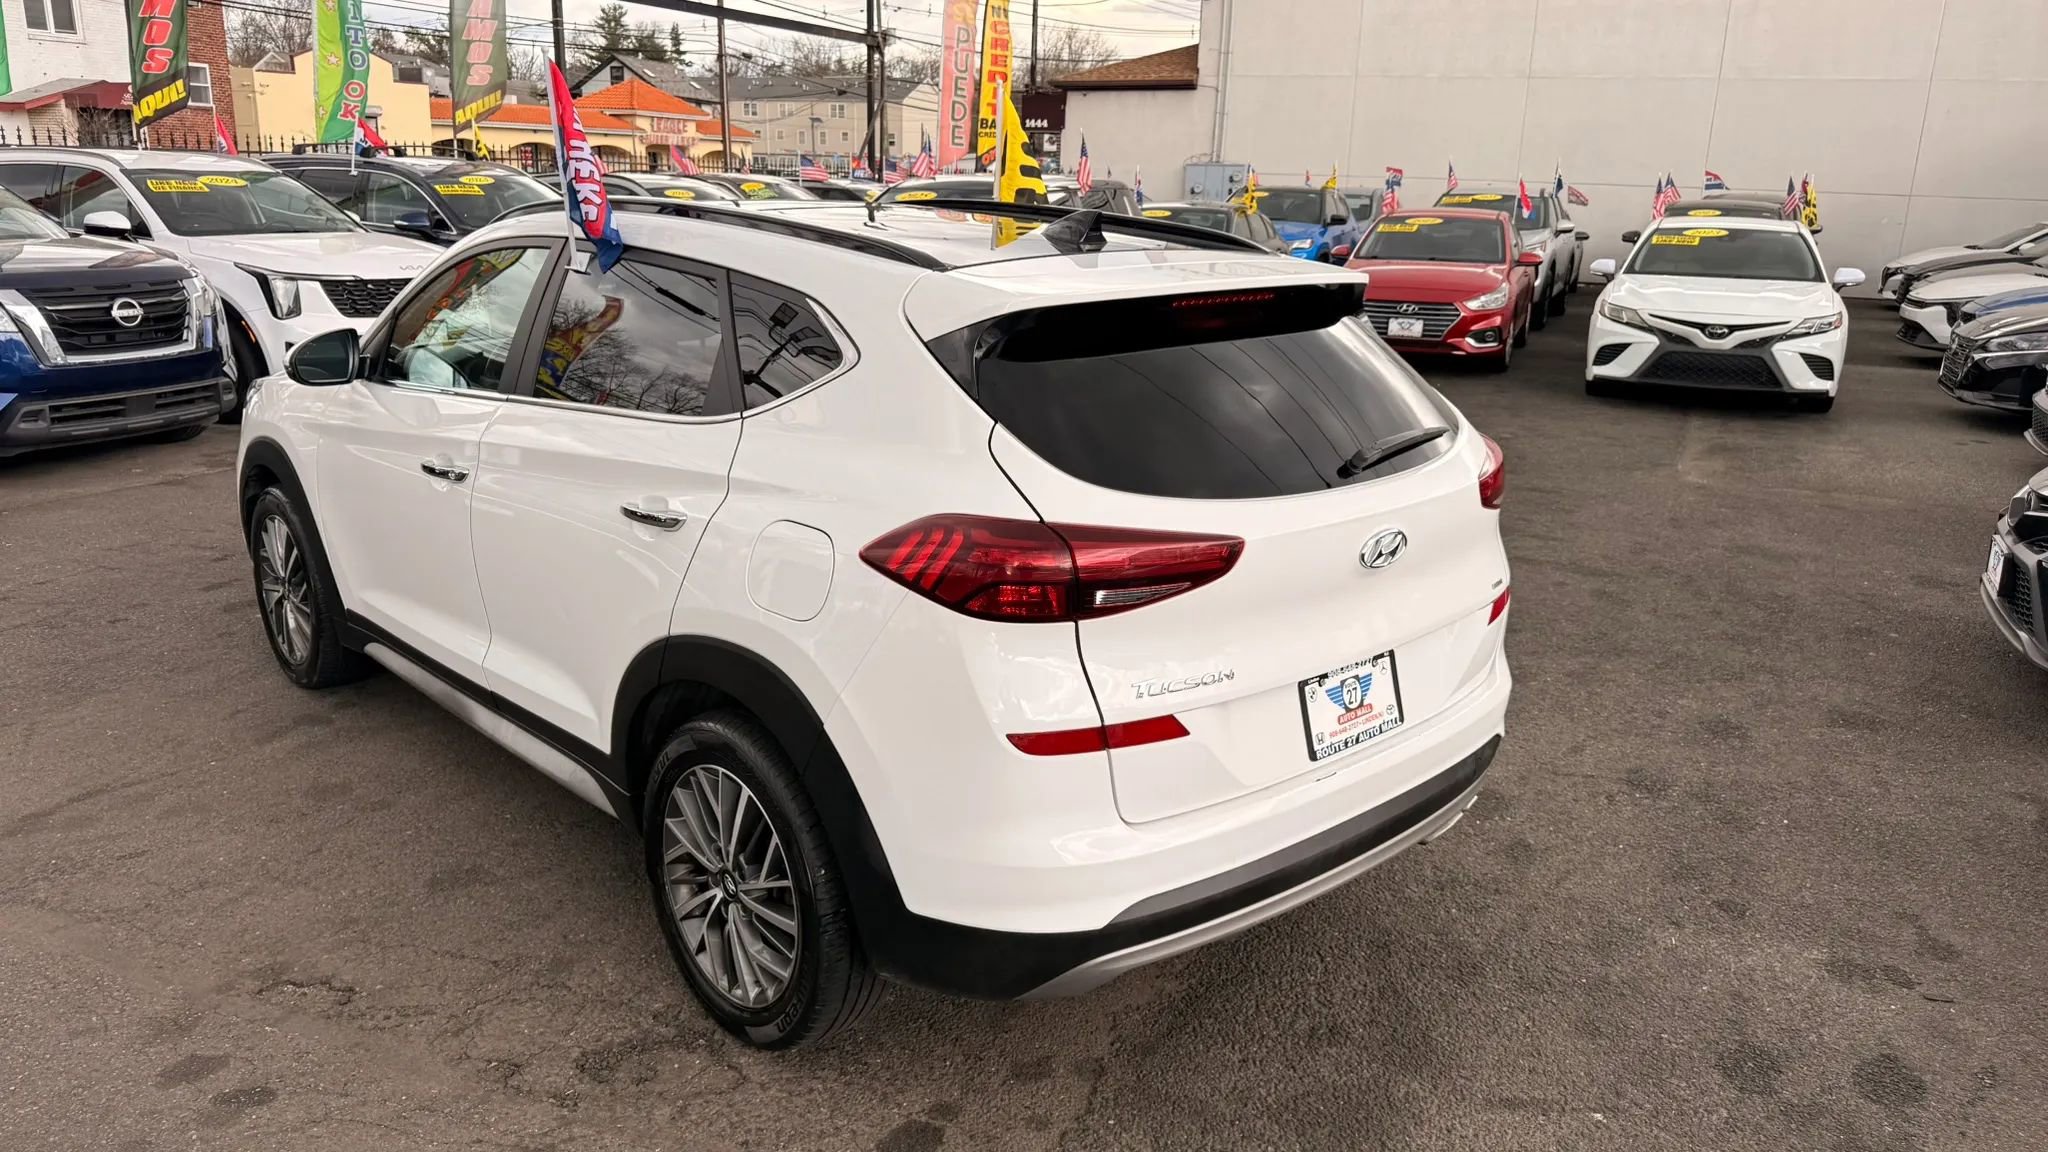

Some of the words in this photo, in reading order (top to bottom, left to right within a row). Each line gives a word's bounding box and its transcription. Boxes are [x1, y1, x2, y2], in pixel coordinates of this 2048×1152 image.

[951, 26, 970, 147] PUEDE
[338, 80, 366, 120] OK
[980, 118, 996, 130] BA
[1025, 118, 1048, 128] 1444
[207, 177, 240, 185] 2024
[1131, 669, 1235, 699] TUCSON
[1346, 687, 1358, 705] 27
[1340, 710, 1356, 724] AUTO
[1356, 703, 1372, 717] MALL
[1316, 741, 1346, 760] ROUTE
[1346, 735, 1357, 748] 27
[1358, 725, 1380, 743] AUTO
[1381, 717, 1402, 732] MALL
